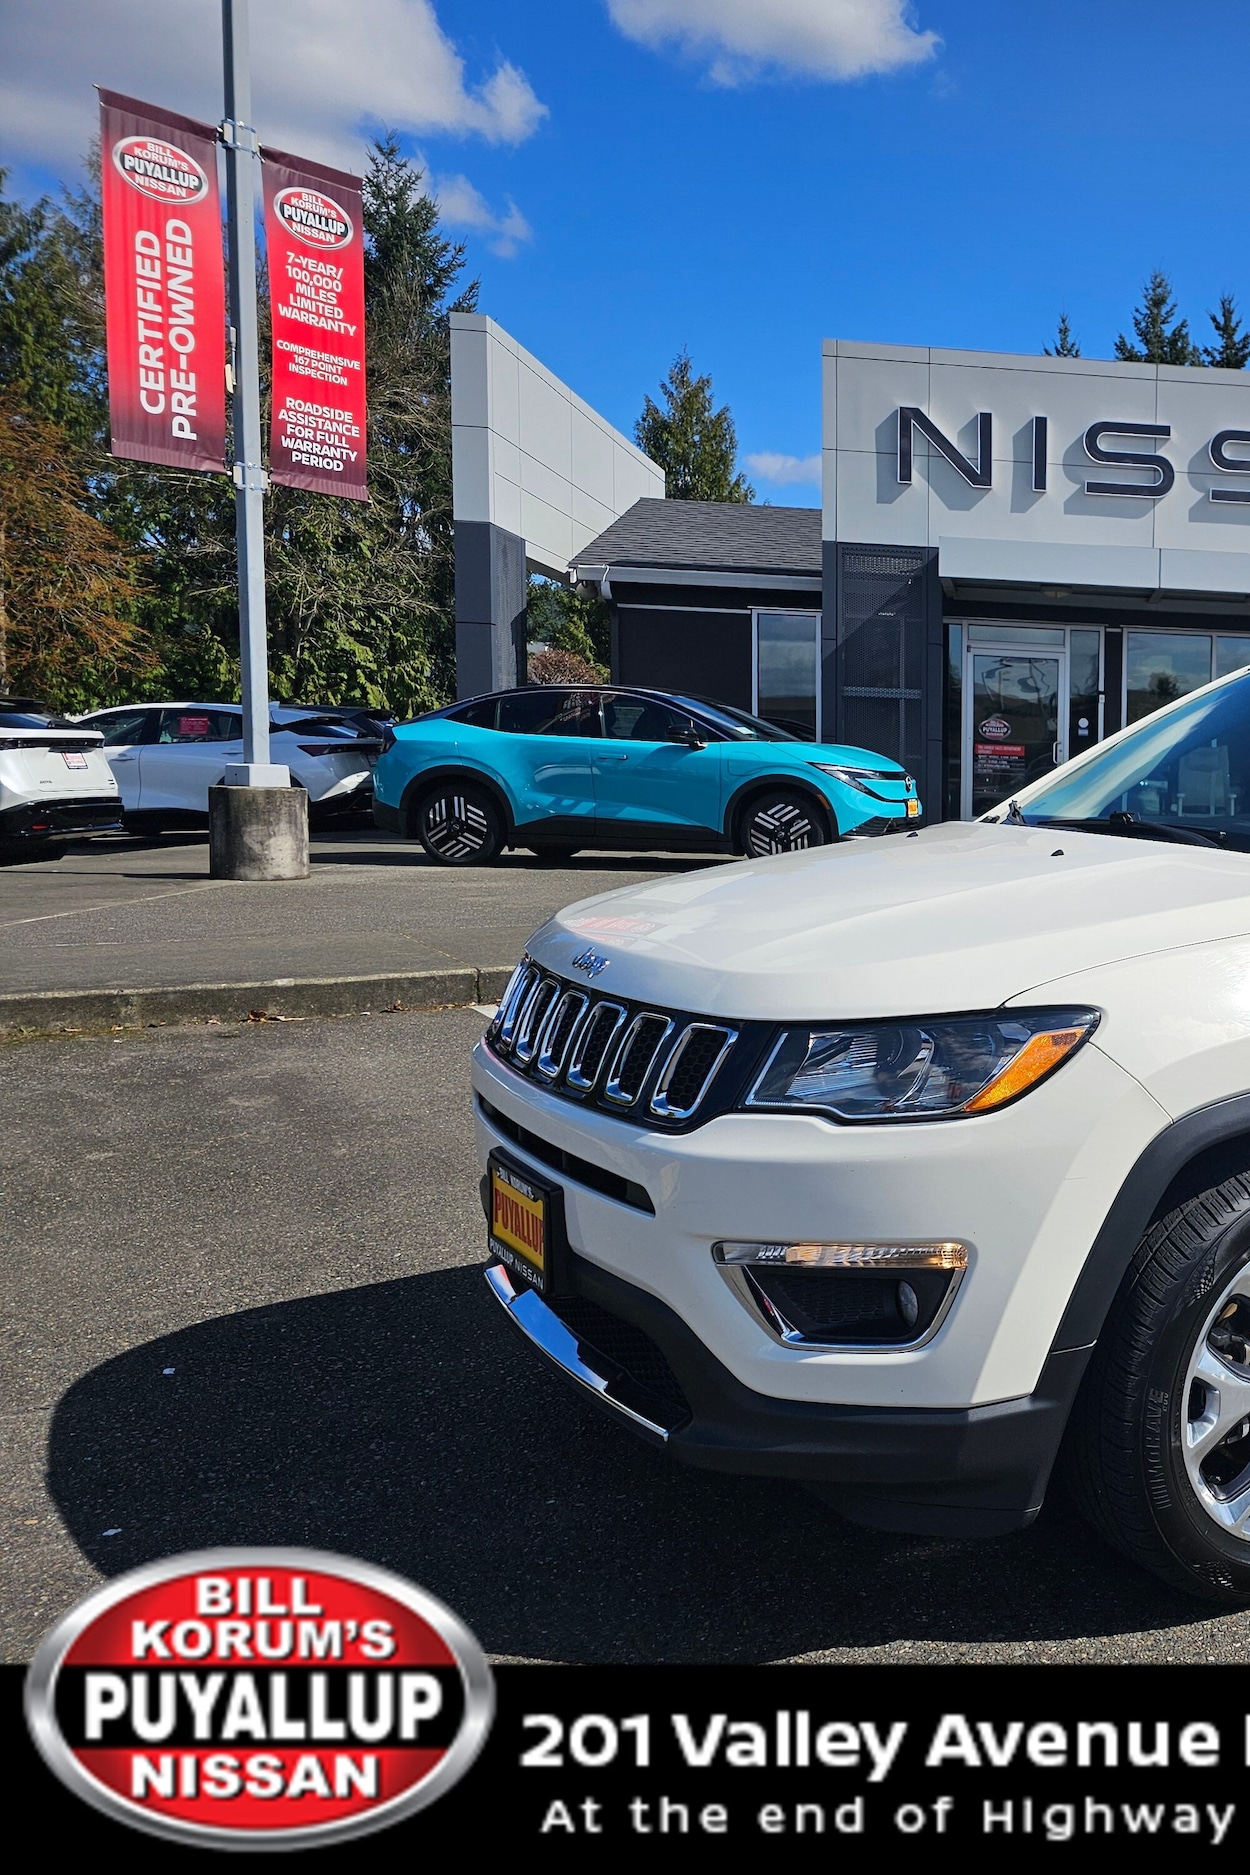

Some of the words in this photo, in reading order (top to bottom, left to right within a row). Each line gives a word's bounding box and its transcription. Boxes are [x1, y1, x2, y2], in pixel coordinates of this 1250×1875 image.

[133, 146, 189, 170] KORUM'S
[146, 141, 174, 158] BILL
[124, 154, 200, 189] PUYALLUP
[134, 173, 187, 197] NISSAN
[291, 196, 337, 219] KORUM'S
[301, 192, 324, 206] BILL
[283, 204, 346, 236] PUYALLUP
[292, 221, 335, 243] NISSAN
[285, 265, 342, 292] 100,000
[286, 251, 344, 280] 7-YEAR/
[289, 293, 344, 320] LIMITED
[295, 282, 337, 304] MILES
[134, 229, 166, 415] CERTIFIED
[165, 218, 198, 441] PRE-OWNED
[278, 303, 357, 336] WARRANTY
[276, 339, 361, 371] COMPREHENSIVE
[293, 354, 310, 368] 167
[311, 359, 343, 376] POINT
[288, 362, 348, 386] INSPECTION
[278, 408, 360, 437] ASSISTANCE
[285, 396, 353, 423] ROADSIDE
[281, 435, 358, 462] WARRANTY
[286, 423, 315, 440] FOR
[316, 430, 350, 448] FULL
[291, 450, 344, 472] PERIOD
[489, 1238, 514, 1265] PUYALLUP
[515, 1258, 544, 1290] NISSAN
